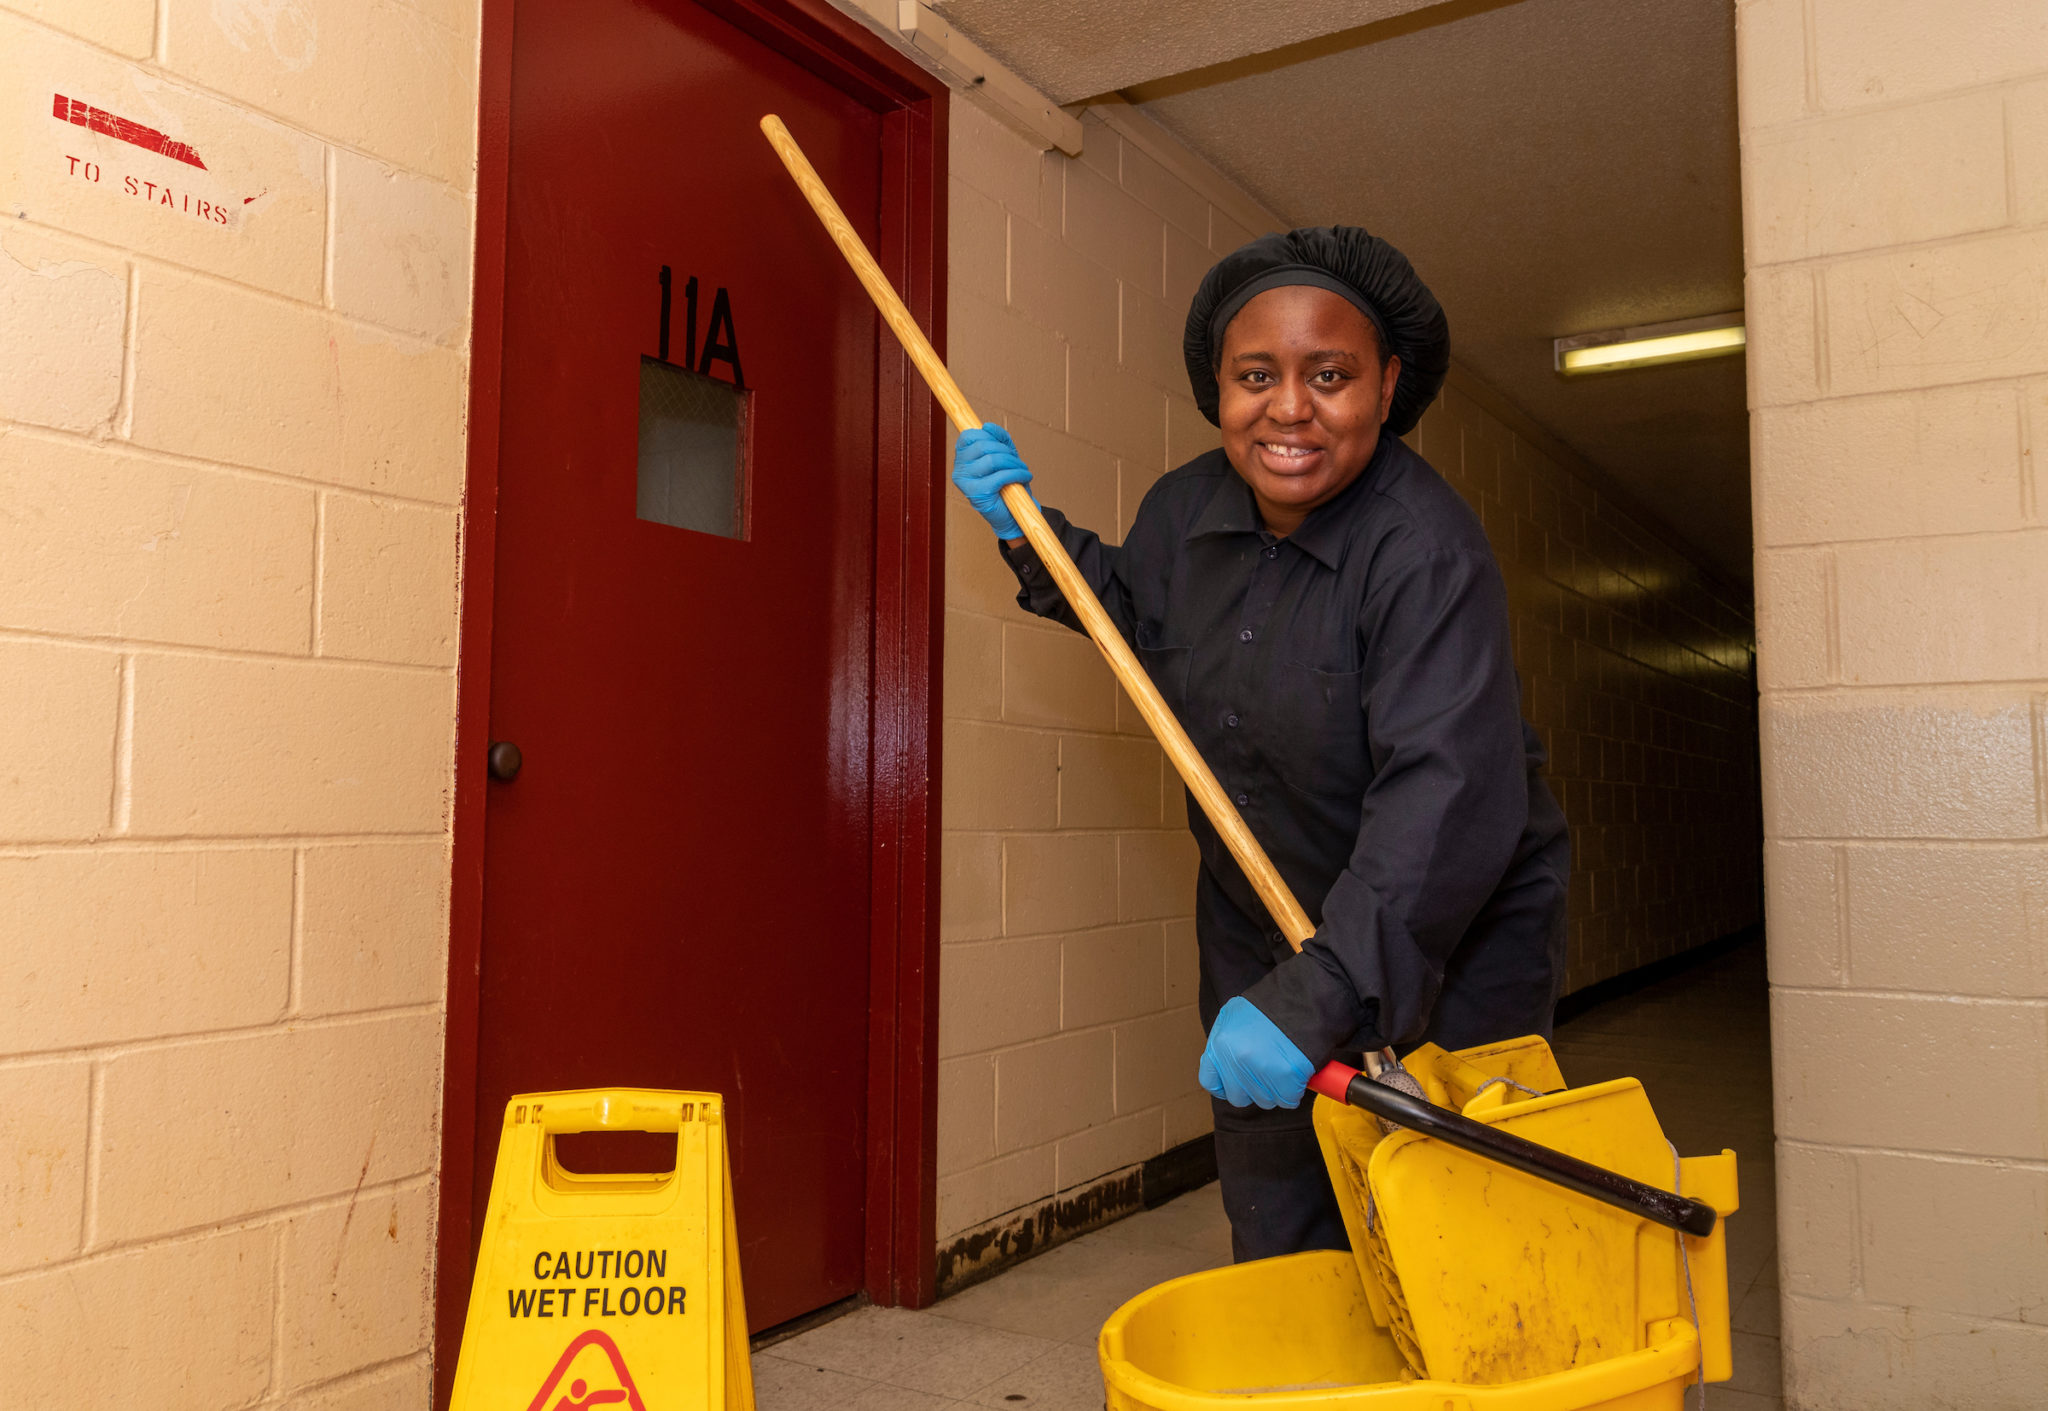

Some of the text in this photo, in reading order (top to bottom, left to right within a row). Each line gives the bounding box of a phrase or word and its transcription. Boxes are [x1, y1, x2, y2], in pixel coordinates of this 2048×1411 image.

[65, 155, 227, 225] TO STAIRS
[659, 265, 745, 388] 11A
[533, 1249, 667, 1280] CAUTION
[508, 1286, 687, 1318] WET FLOOR
